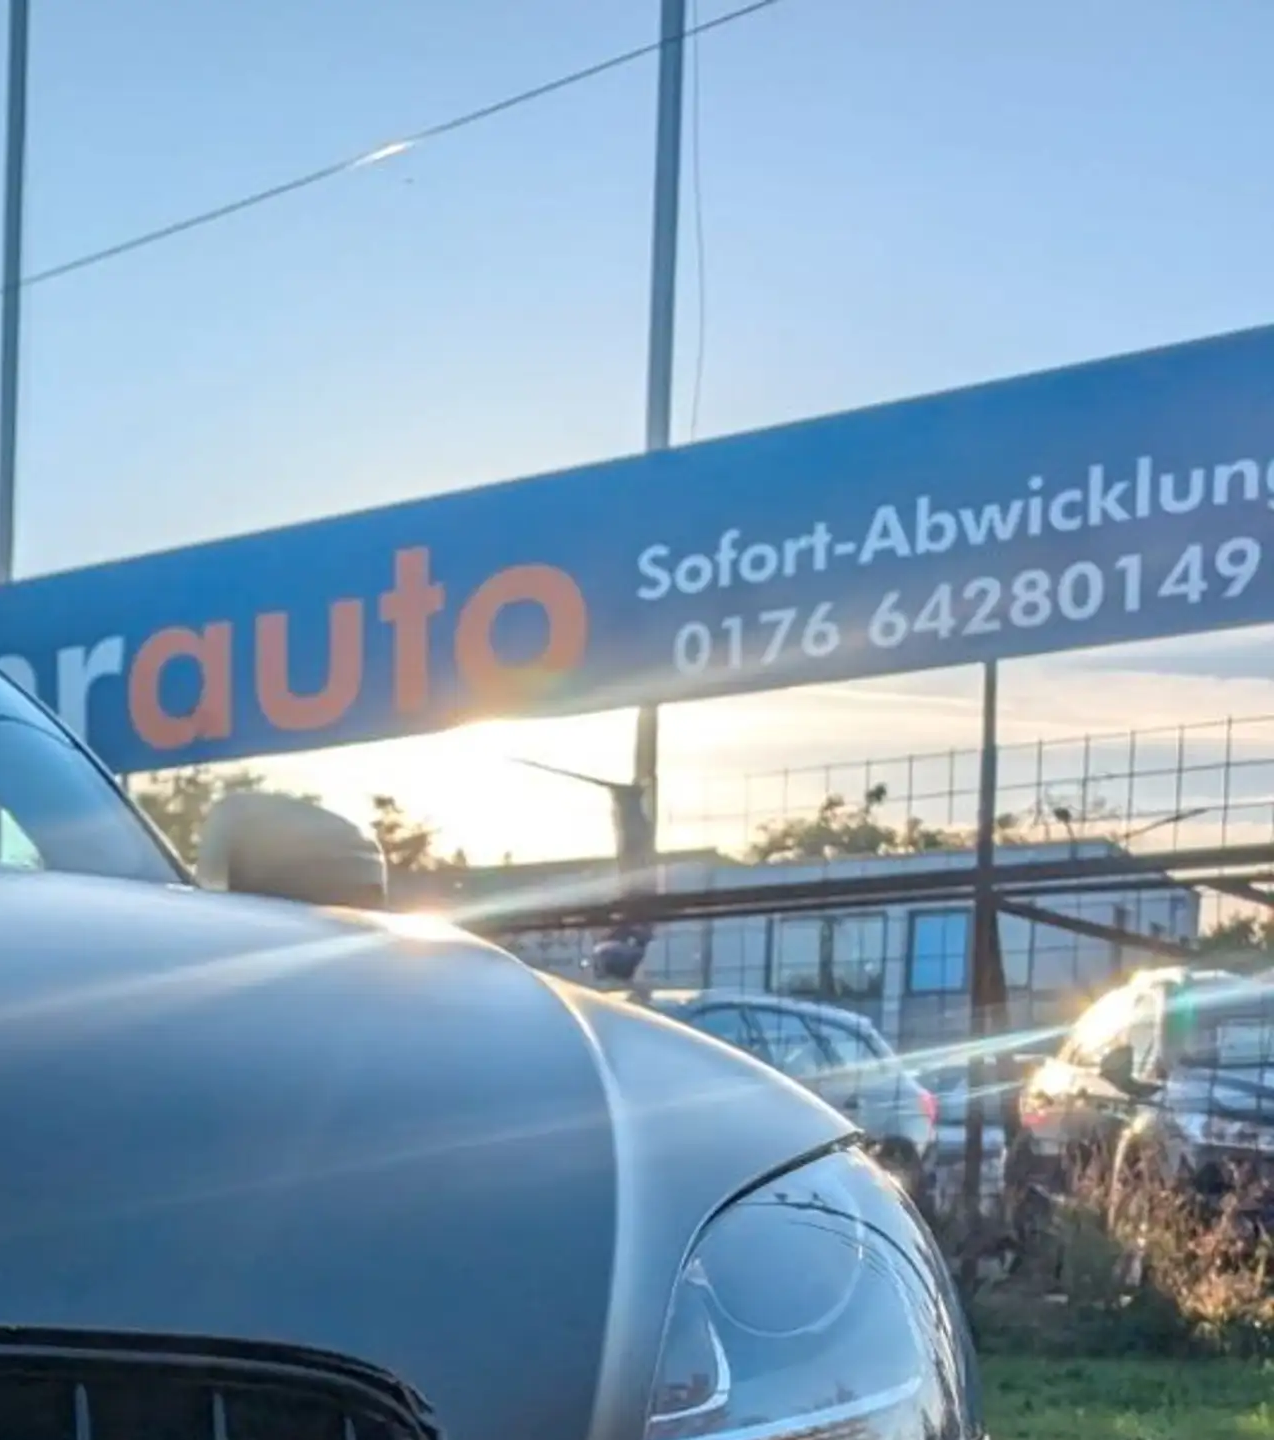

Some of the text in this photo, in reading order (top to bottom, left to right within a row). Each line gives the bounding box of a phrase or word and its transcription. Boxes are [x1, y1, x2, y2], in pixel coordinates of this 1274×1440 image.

[637, 456, 1274, 602] Sofort-Abwicklun
[673, 537, 1262, 676] 0176 64280149
